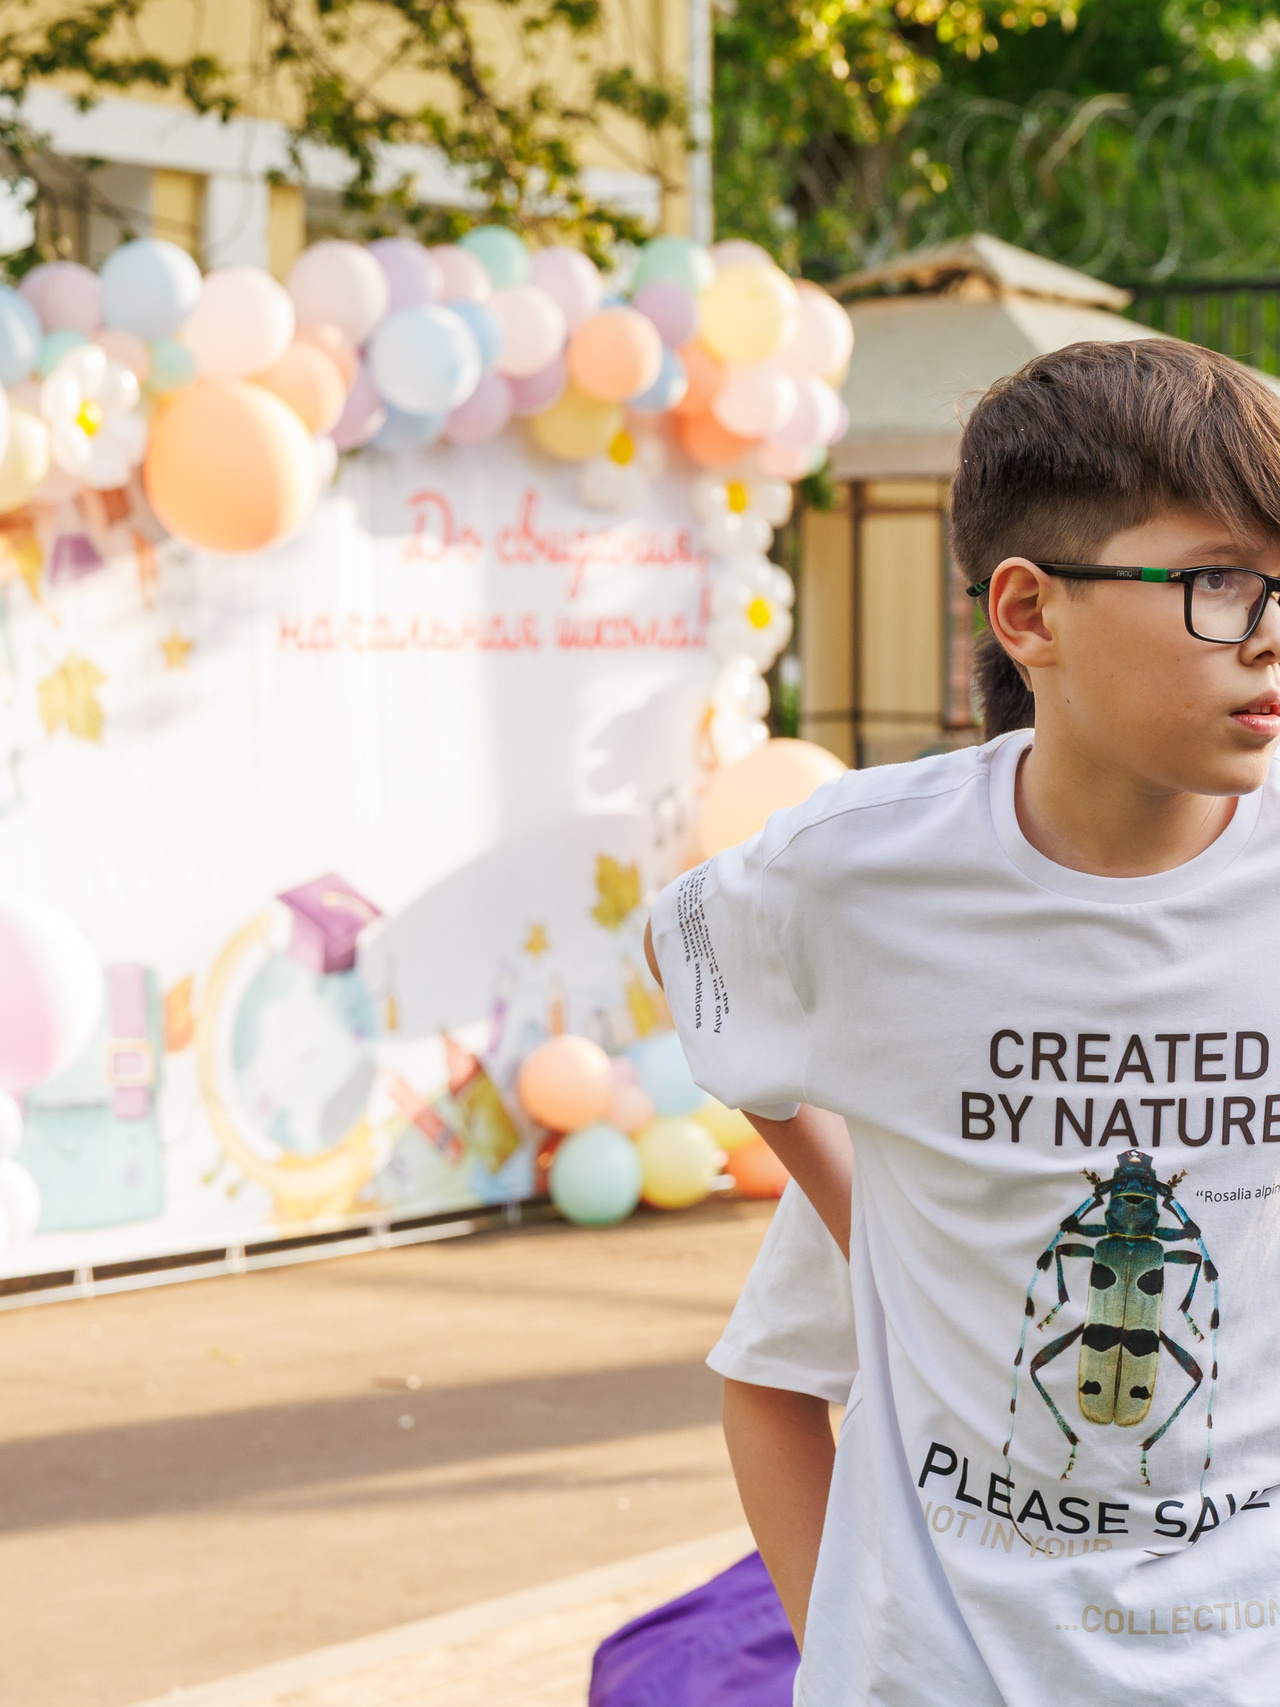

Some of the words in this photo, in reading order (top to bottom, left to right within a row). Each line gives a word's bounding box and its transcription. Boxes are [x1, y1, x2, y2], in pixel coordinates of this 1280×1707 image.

[695, 908, 709, 959] species
[704, 924, 719, 973] decline
[718, 975, 725, 989] in
[695, 962, 703, 1030] ambitions
[712, 979, 721, 1002] not
[713, 1005, 723, 1034] only
[989, 1029, 1270, 1084] CREATED
[961, 1092, 1034, 1142] BY
[1196, 1187, 1251, 1203] “Rosalia
[918, 1442, 1130, 1534] PLEASE
[980, 1519, 1015, 1553] IN
